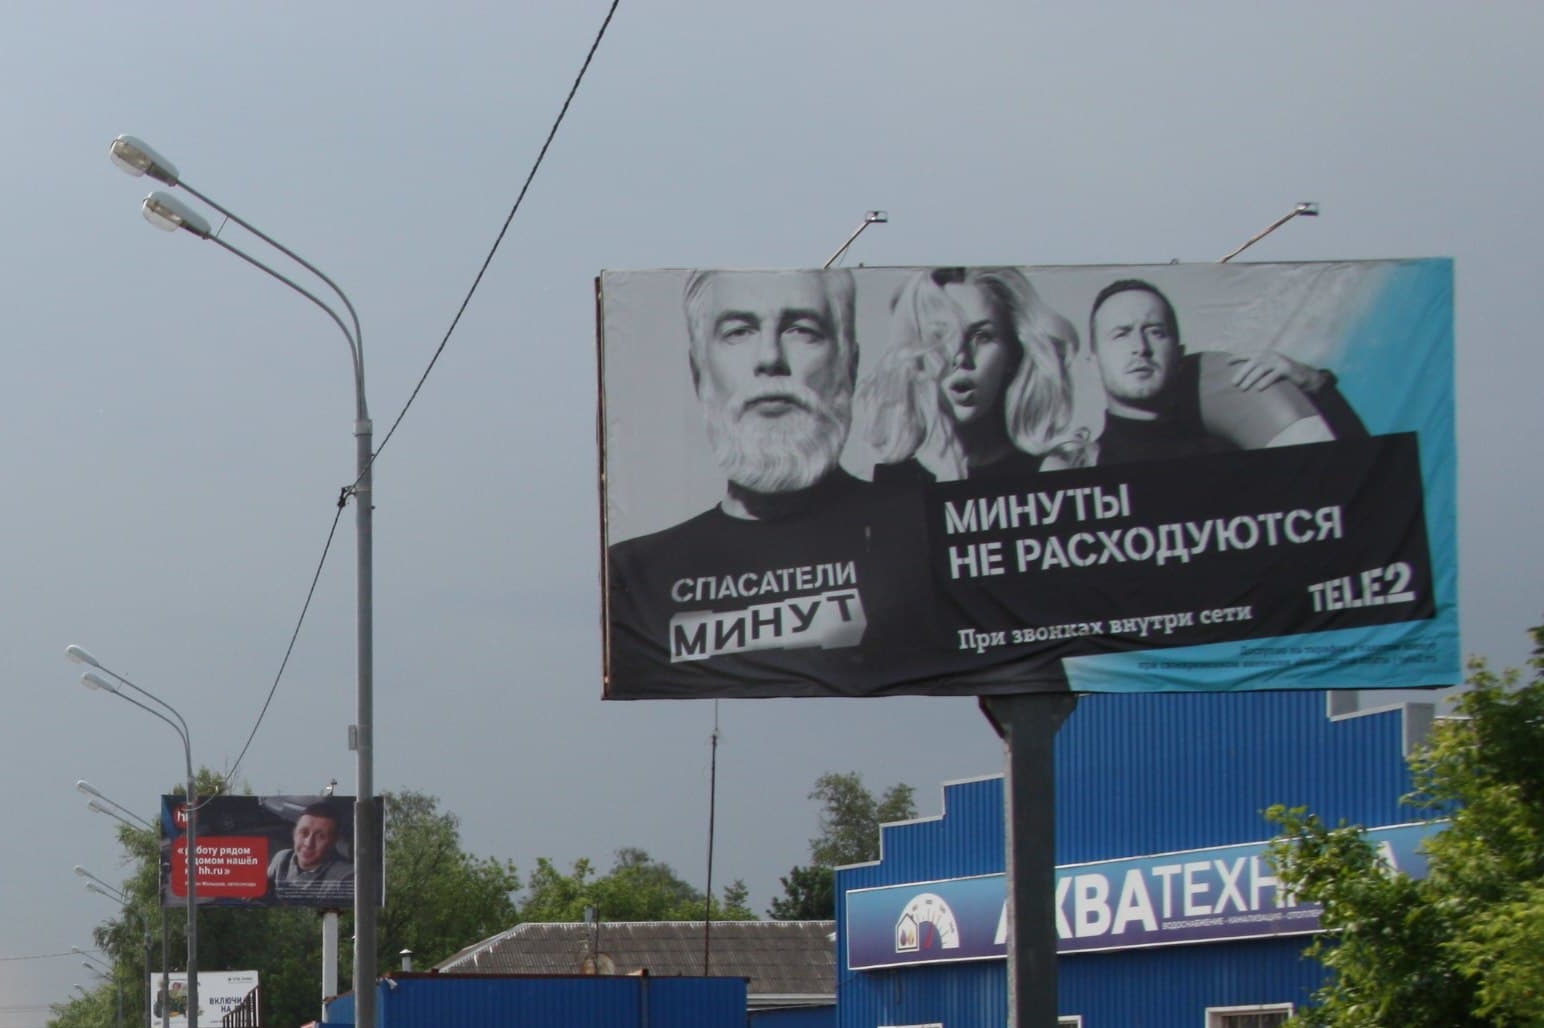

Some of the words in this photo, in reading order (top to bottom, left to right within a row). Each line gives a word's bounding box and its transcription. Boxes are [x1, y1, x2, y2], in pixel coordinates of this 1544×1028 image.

[944, 483, 1132, 535] МИНУТЫ
[949, 541, 1005, 580] НЕ
[1017, 505, 1344, 573] РАСХОДУЮТСЯ
[671, 561, 857, 602] СПАСАТЕЛИ
[1308, 561, 1416, 613] TELE2
[674, 593, 856, 658] МИНУТ
[958, 627, 1006, 655] При
[1012, 619, 1103, 645] звонках
[1109, 611, 1193, 642] внутри
[1200, 604, 1253, 626] сети
[220, 847, 251, 857] рядом
[226, 856, 258, 865] нашёл
